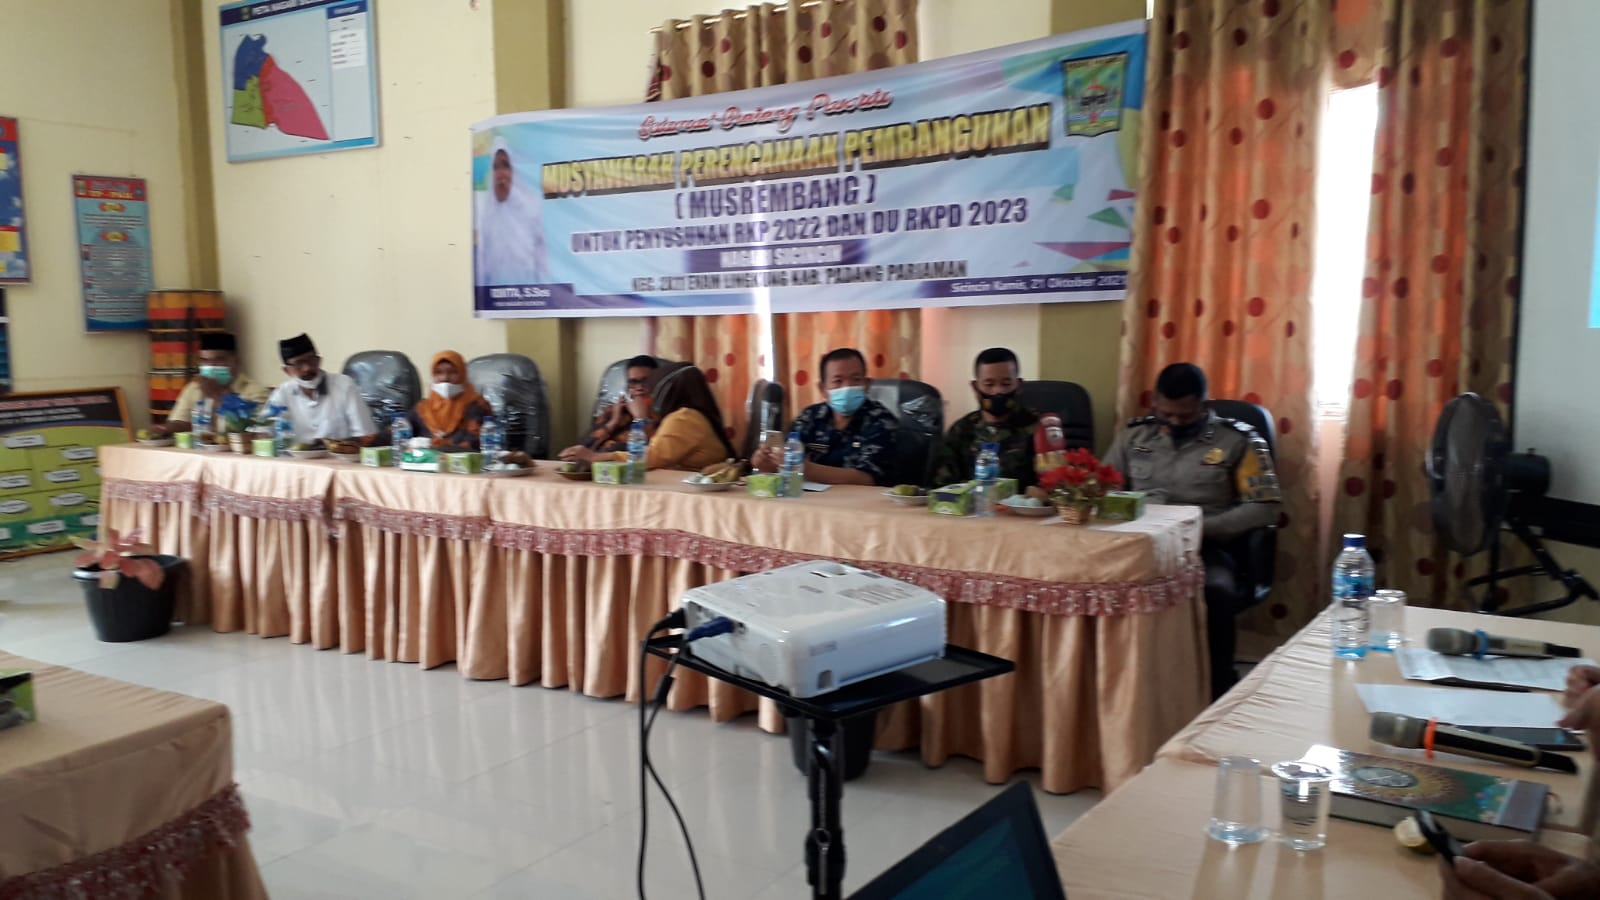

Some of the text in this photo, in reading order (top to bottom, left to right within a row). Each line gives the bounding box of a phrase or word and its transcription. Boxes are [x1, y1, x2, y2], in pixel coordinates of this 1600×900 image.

[720, 105, 800, 134] Datang
[542, 101, 1051, 199] MUSYAWARAH PERENCANAAN PEMBANGUNAN
[571, 197, 1028, 252] UNTUK PENYUSUNAN RKP 2022 DAN DU RKPD 2023
